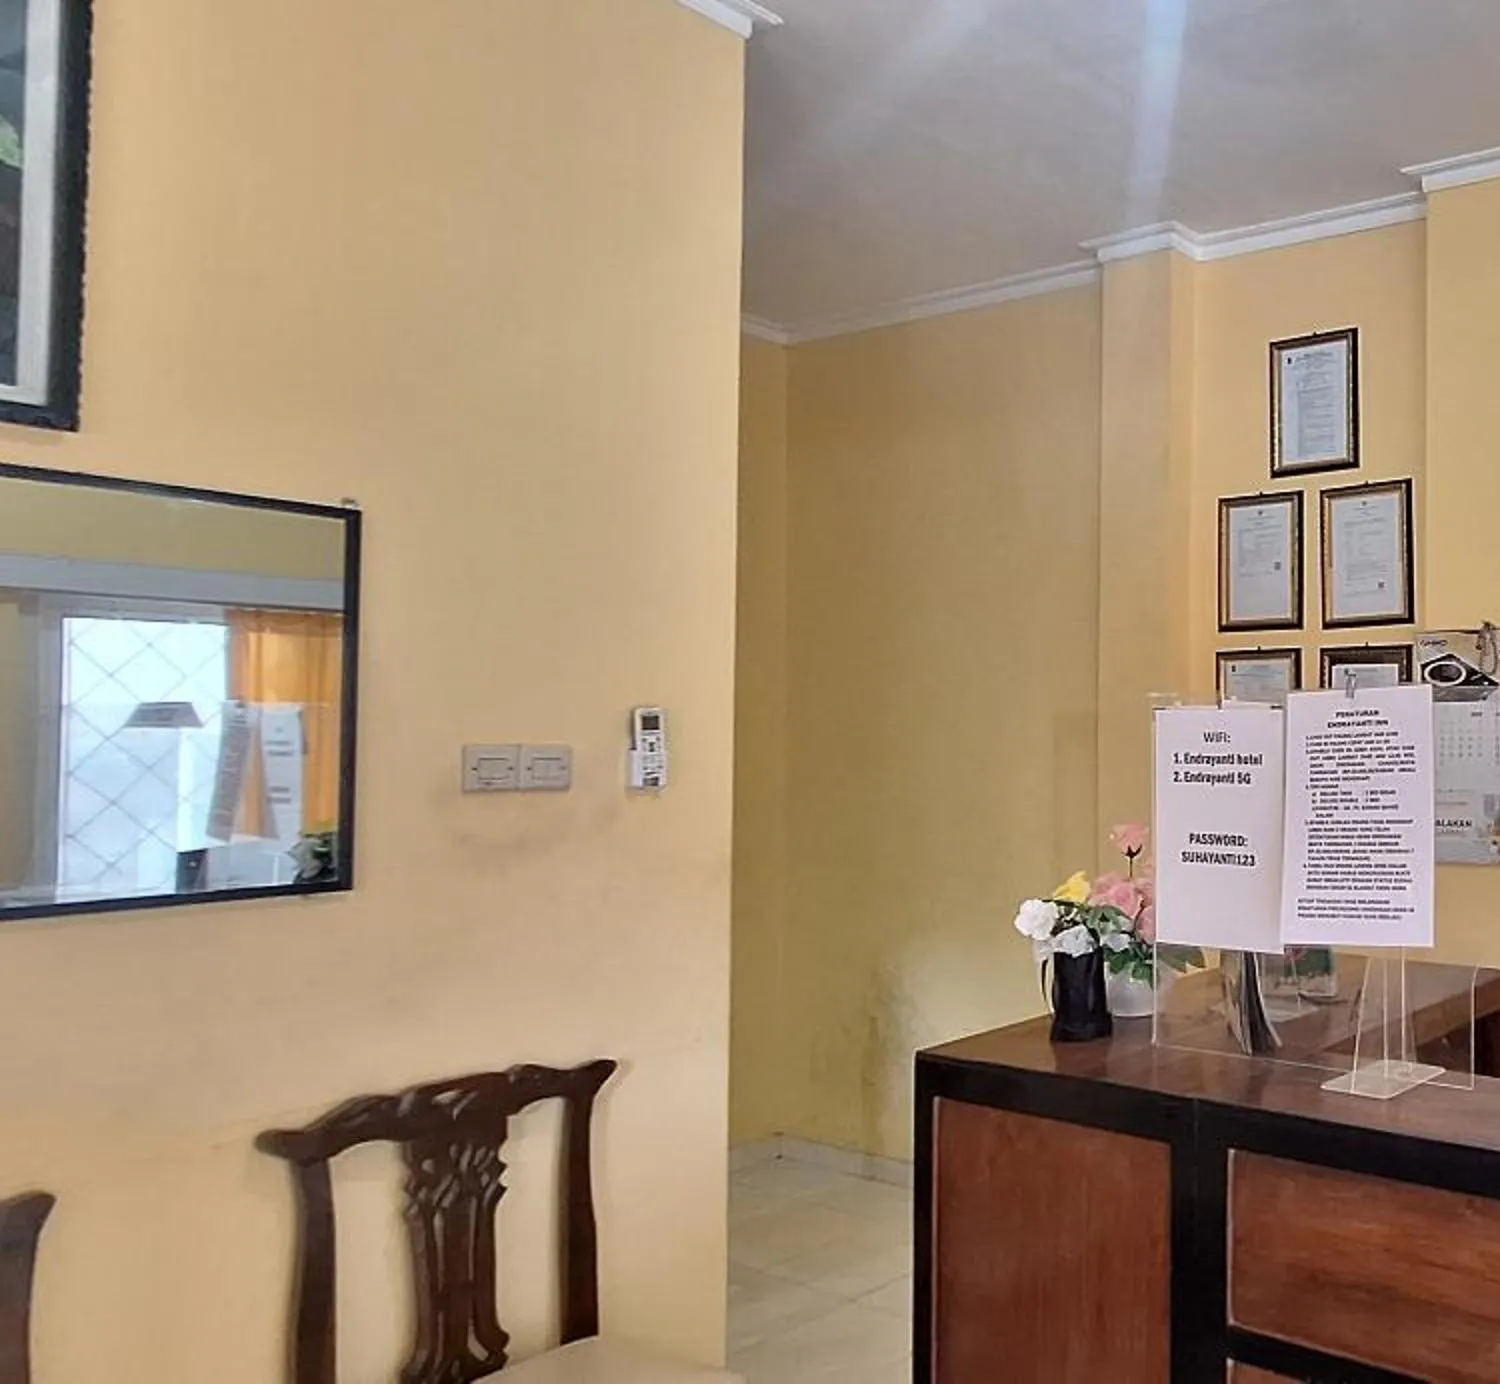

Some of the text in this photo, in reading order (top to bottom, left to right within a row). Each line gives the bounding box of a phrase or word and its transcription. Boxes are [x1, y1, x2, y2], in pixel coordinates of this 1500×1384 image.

[1173, 752, 1263, 767] 1. Endrayanti hotel
[1173, 771, 1251, 786] 2. Endrayanti 5G
[1189, 832, 1248, 847] PASSWORD:
[1181, 851, 1256, 867] SUHAYANTI123
